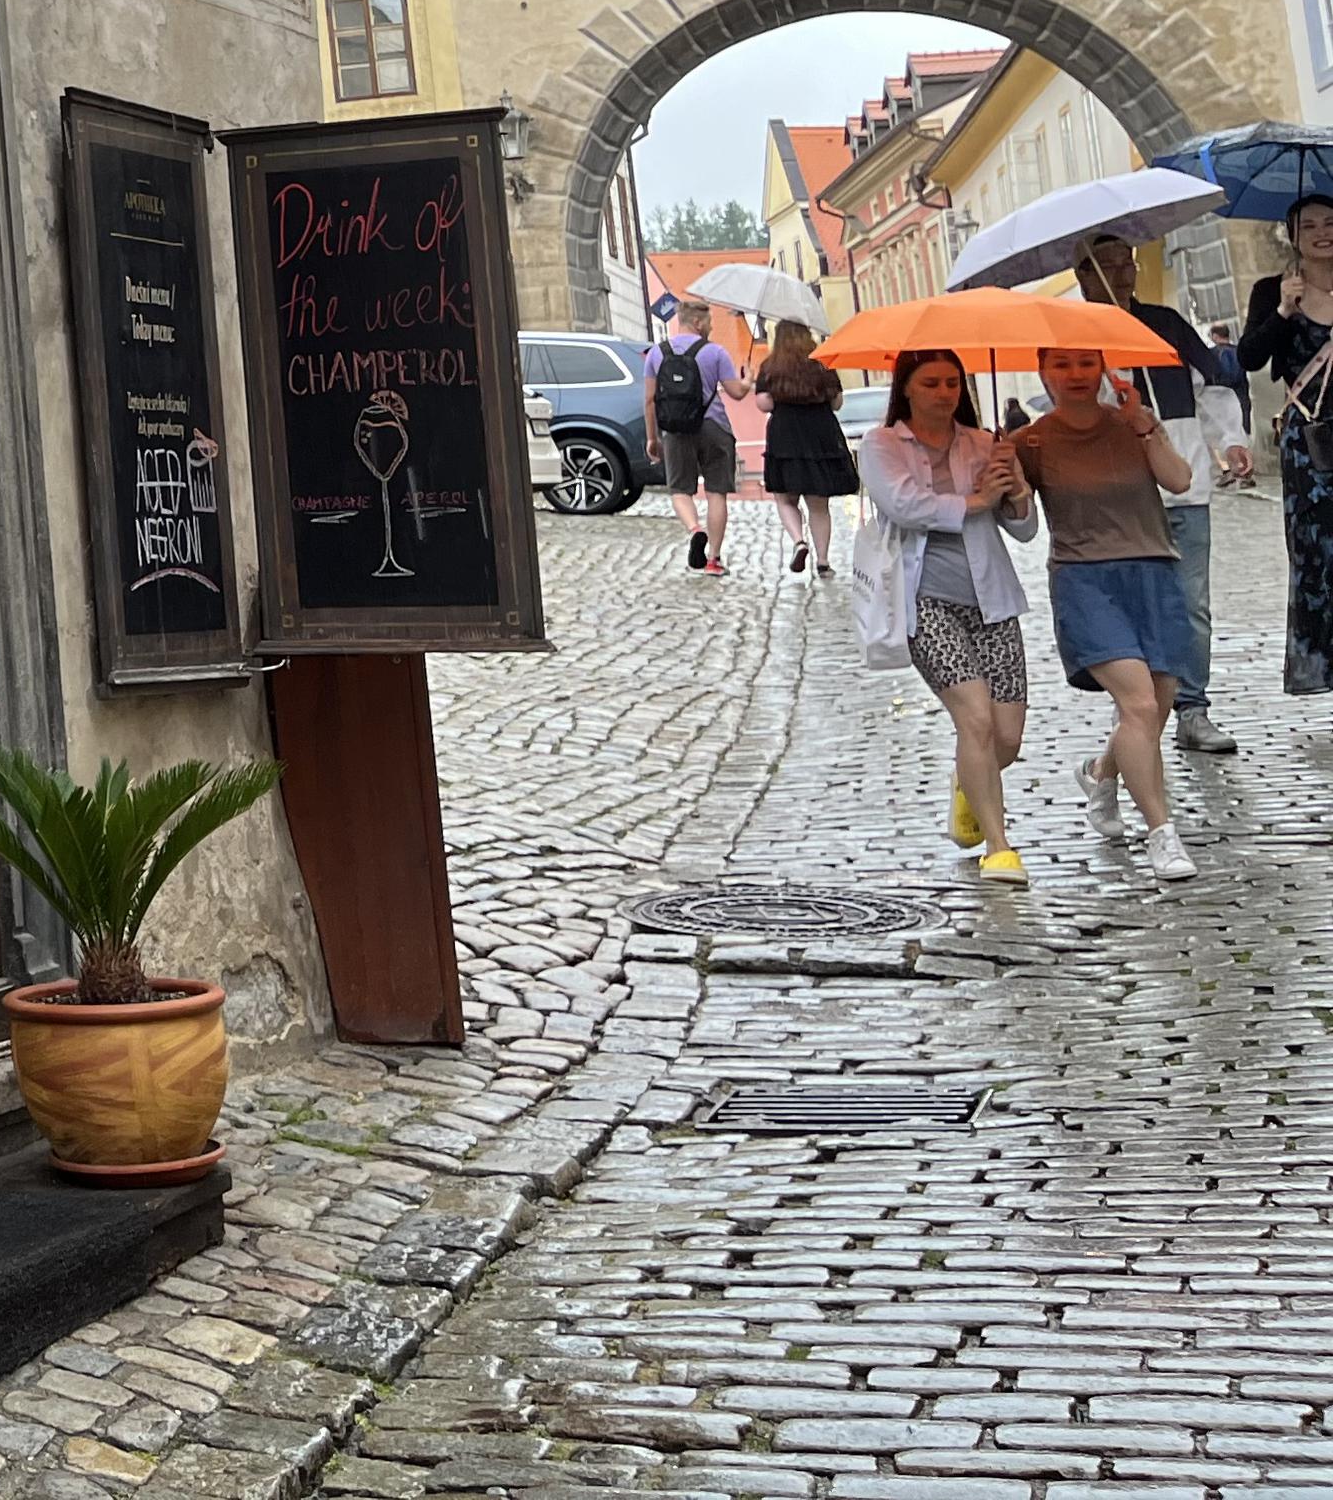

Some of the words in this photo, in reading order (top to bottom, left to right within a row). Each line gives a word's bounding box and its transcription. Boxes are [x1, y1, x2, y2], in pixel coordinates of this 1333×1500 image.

[273, 177, 405, 268] Drink
[279, 274, 349, 338] the
[135, 515, 203, 567] NEGRONI
